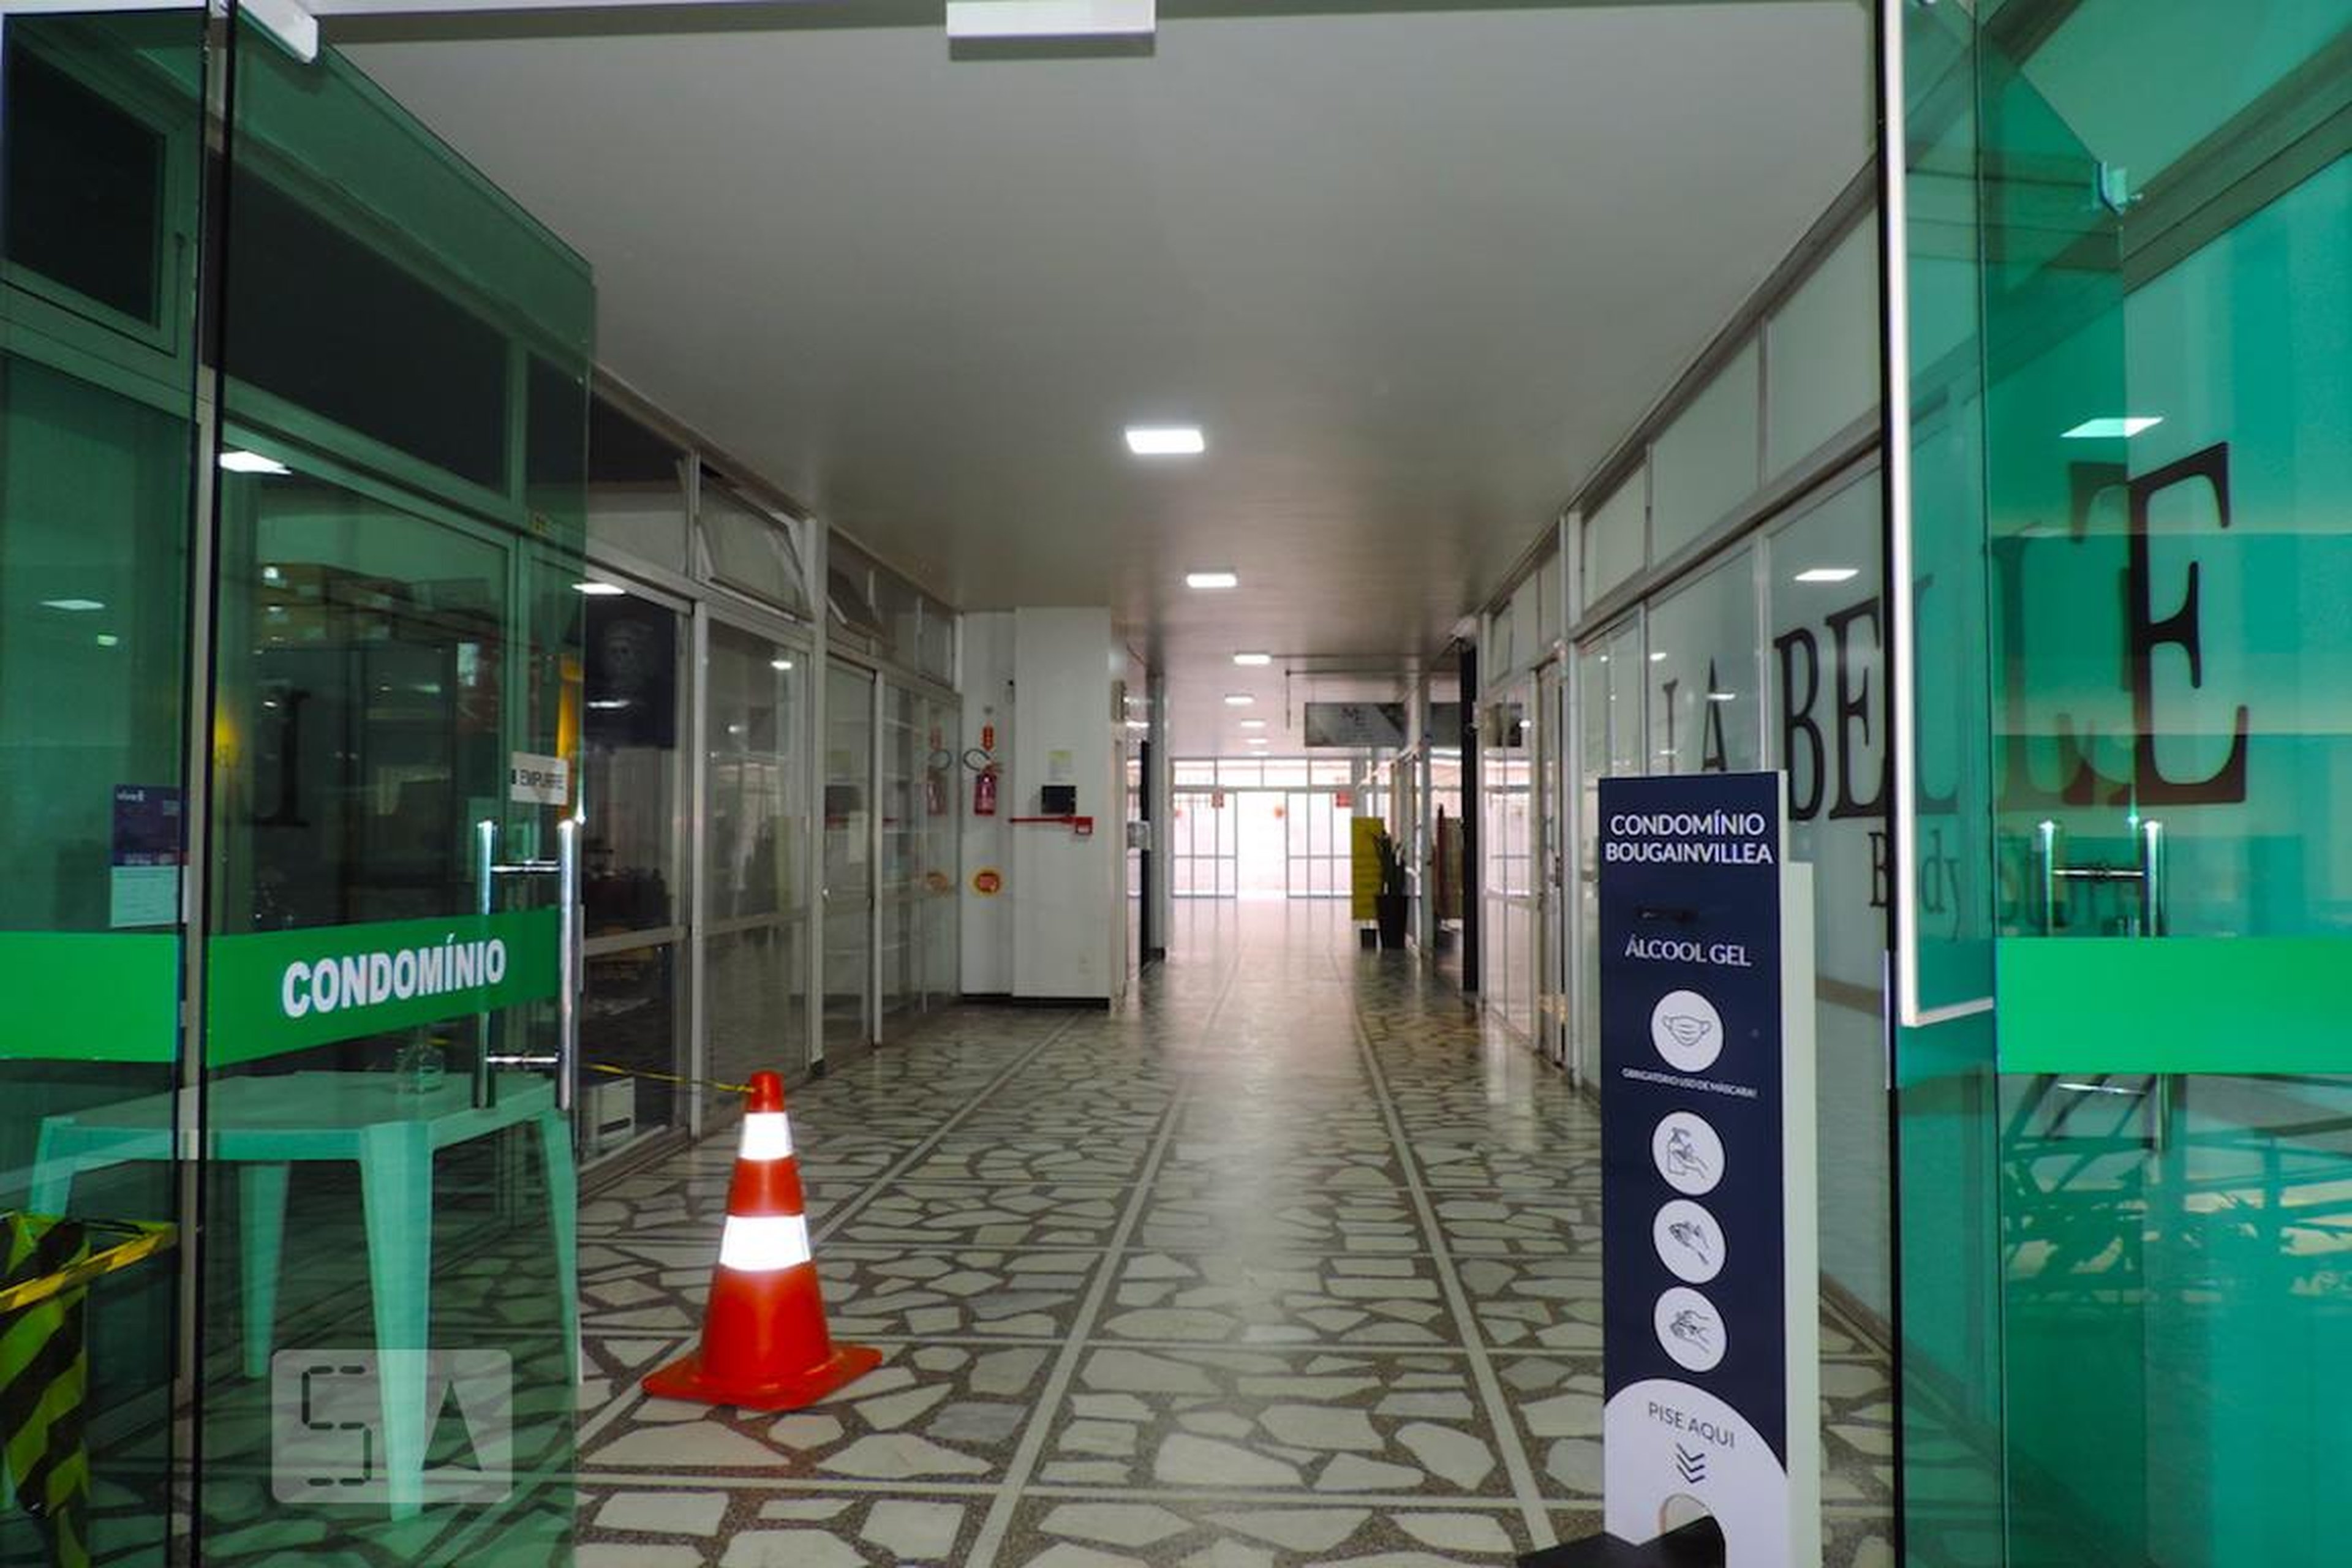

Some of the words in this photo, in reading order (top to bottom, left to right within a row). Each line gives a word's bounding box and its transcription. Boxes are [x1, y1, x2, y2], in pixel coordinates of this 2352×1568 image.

[1610, 809, 1766, 837] CONDOMÍNIO
[1605, 842, 1774, 865] BOUGAINVILLEA
[1624, 934, 1708, 963] ÁLCOOL
[1709, 944, 1752, 967] GEL
[282, 932, 508, 1019] CONDOMÍNIO
[1648, 1401, 1684, 1430] PISE
[1688, 1417, 1735, 1449] AQUI
